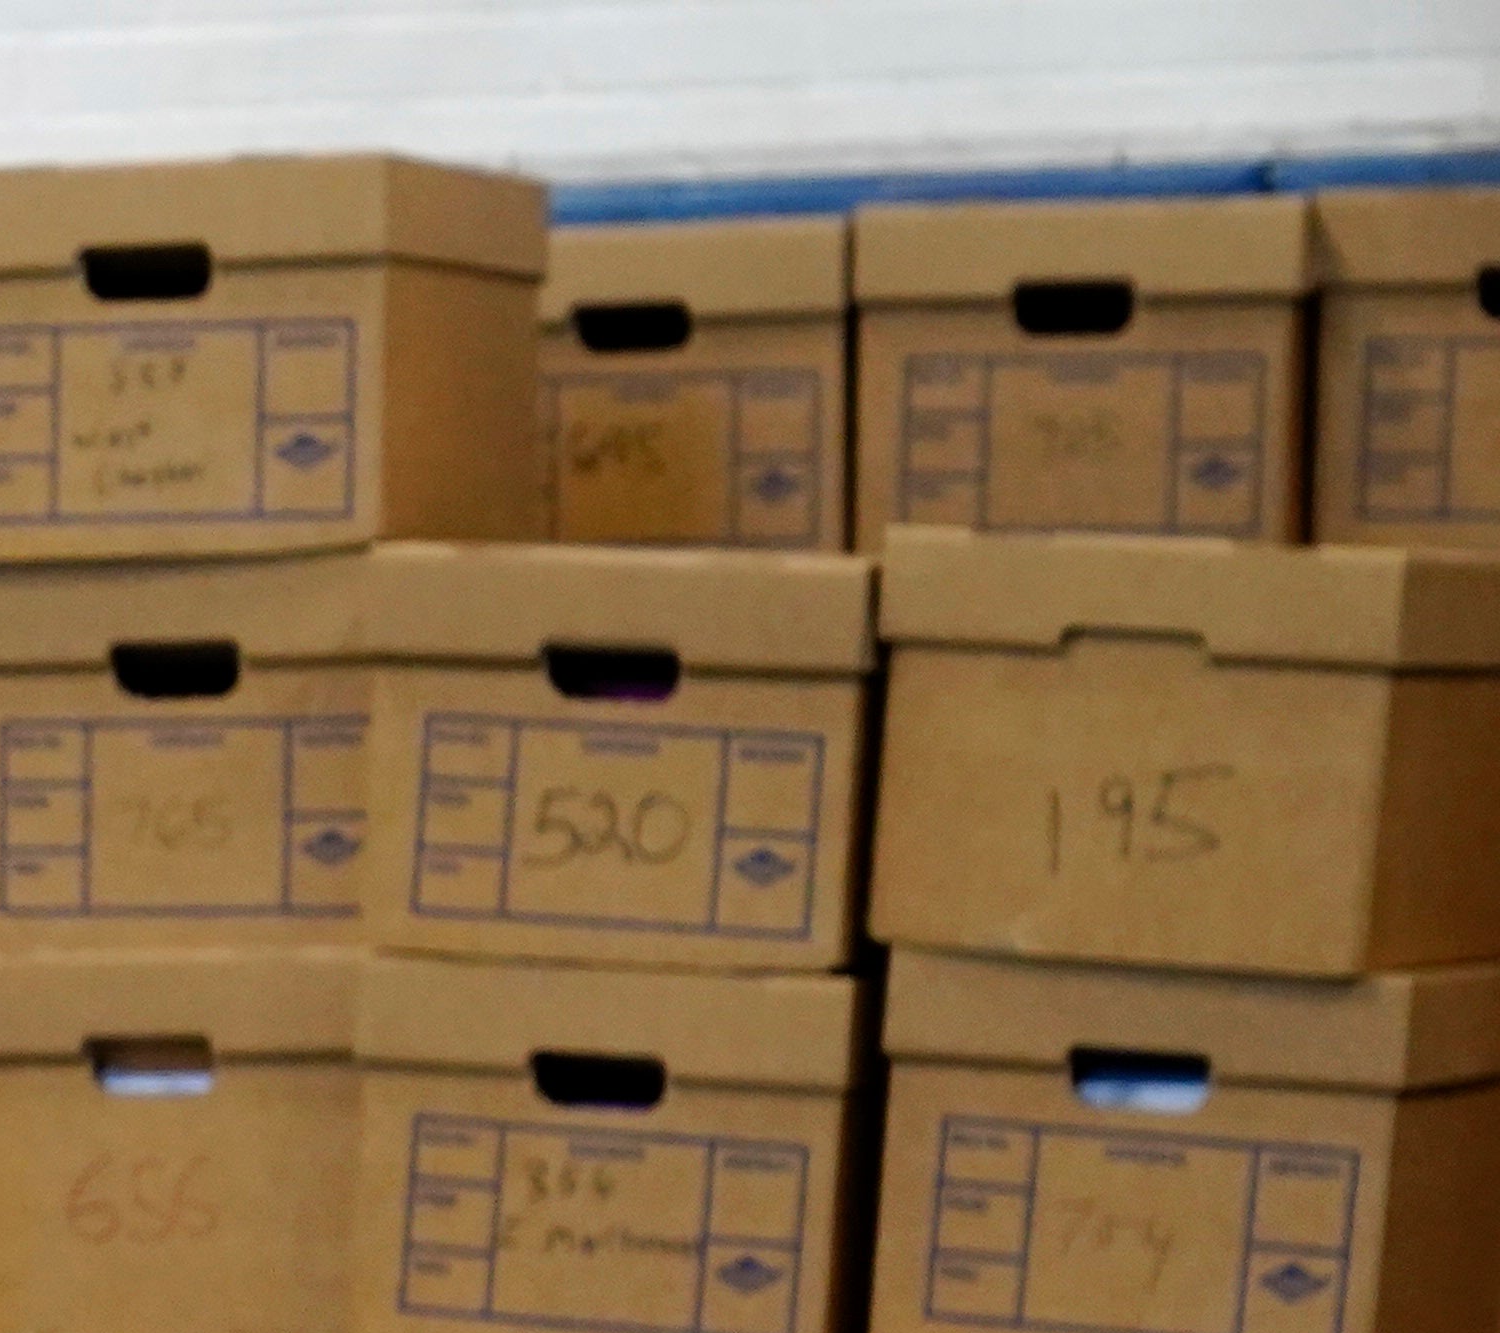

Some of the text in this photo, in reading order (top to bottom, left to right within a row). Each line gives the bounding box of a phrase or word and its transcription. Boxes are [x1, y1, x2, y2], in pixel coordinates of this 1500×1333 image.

[521, 787, 694, 869] 520
[1044, 769, 1238, 875] 195
[63, 1152, 222, 1245] 656
